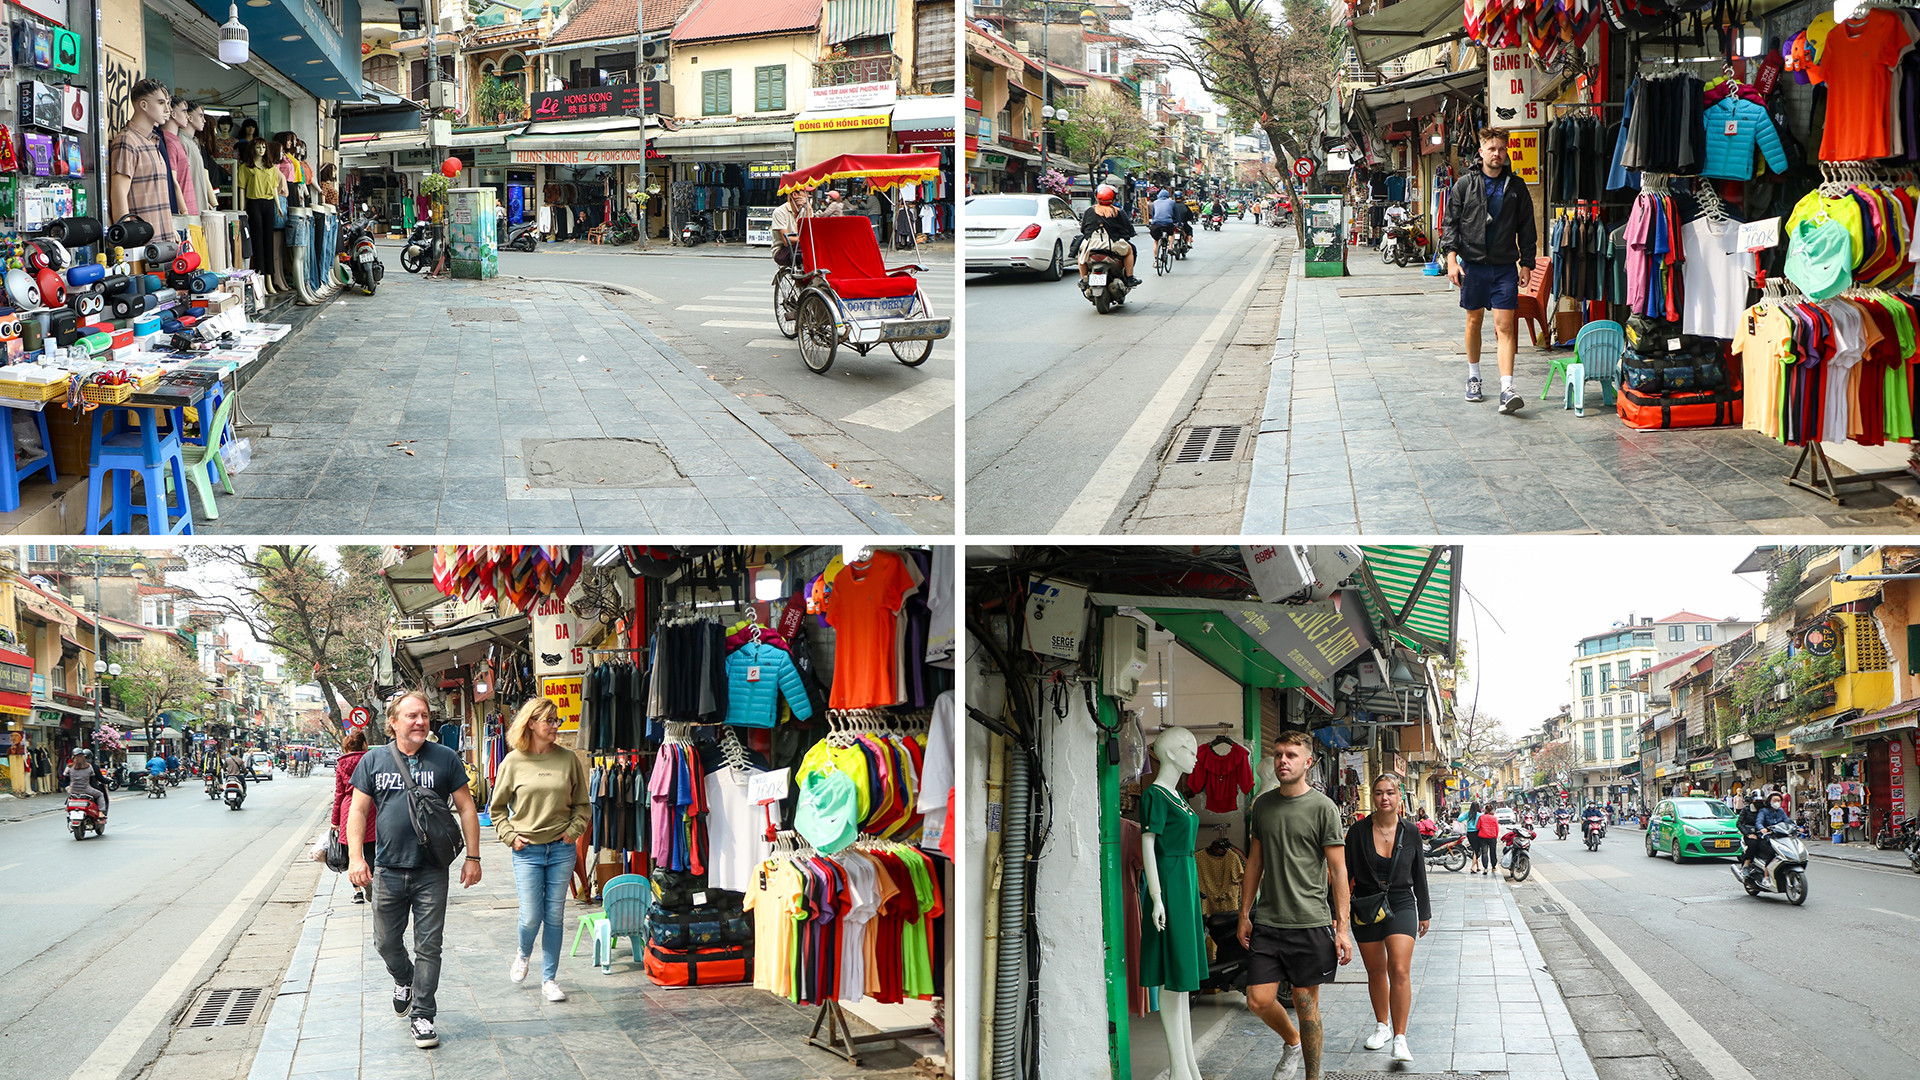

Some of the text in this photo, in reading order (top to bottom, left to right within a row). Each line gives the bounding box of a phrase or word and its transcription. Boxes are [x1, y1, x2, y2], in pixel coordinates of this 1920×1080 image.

[1510, 78, 1524, 94] DA
[564, 91, 613, 105] HONG KONG
[535, 97, 560, 116] Lệ
[1525, 102, 1538, 119] 15
[861, 117, 885, 127] NGỌC
[1523, 137, 1537, 148] TAY
[601, 151, 620, 161] HONG
[621, 150, 641, 161] KONG
[1512, 150, 1523, 161] DA
[1522, 167, 1538, 175] 100%
[874, 299, 905, 310] WORRY
[1254, 547, 1277, 564] 698H
[1034, 596, 1055, 606] VNPT
[555, 623, 570, 640] DA
[1051, 635, 1075, 648] SERGE
[1315, 626, 1360, 667] ANH
[571, 648, 584, 664] 15
[545, 681, 567, 695] GĂNG
[558, 697, 570, 708] DA
[569, 714, 580, 723] 100
